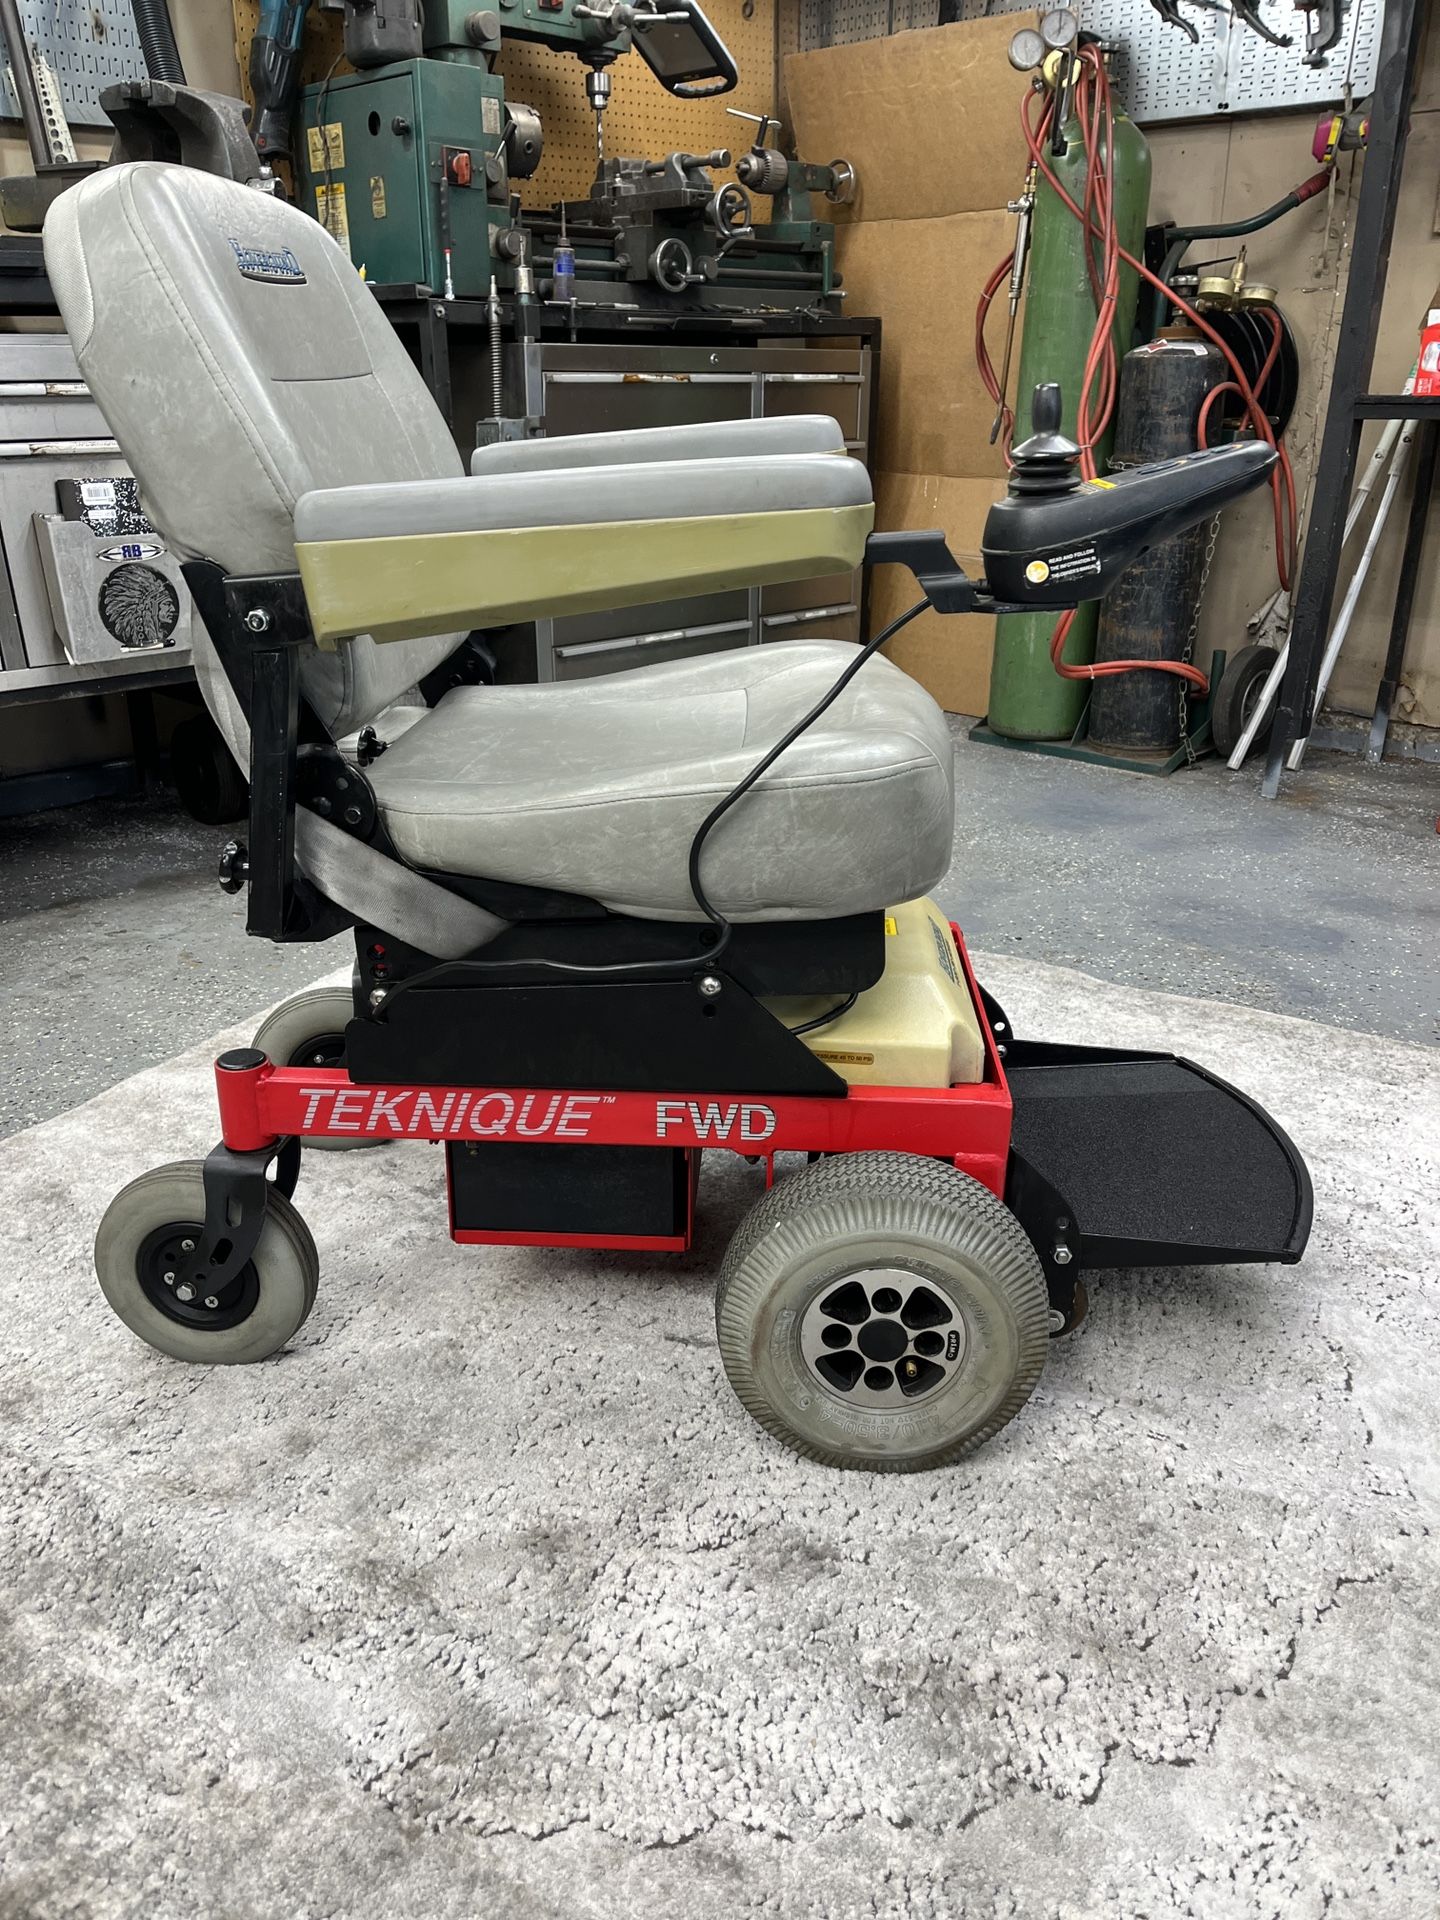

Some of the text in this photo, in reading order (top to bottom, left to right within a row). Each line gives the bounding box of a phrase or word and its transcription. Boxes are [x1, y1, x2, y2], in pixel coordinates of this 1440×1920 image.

[1074, 548, 1094, 557] FOLLOW
[656, 1101, 776, 1141] FWD
[947, 1333, 957, 1358] PRIMO
